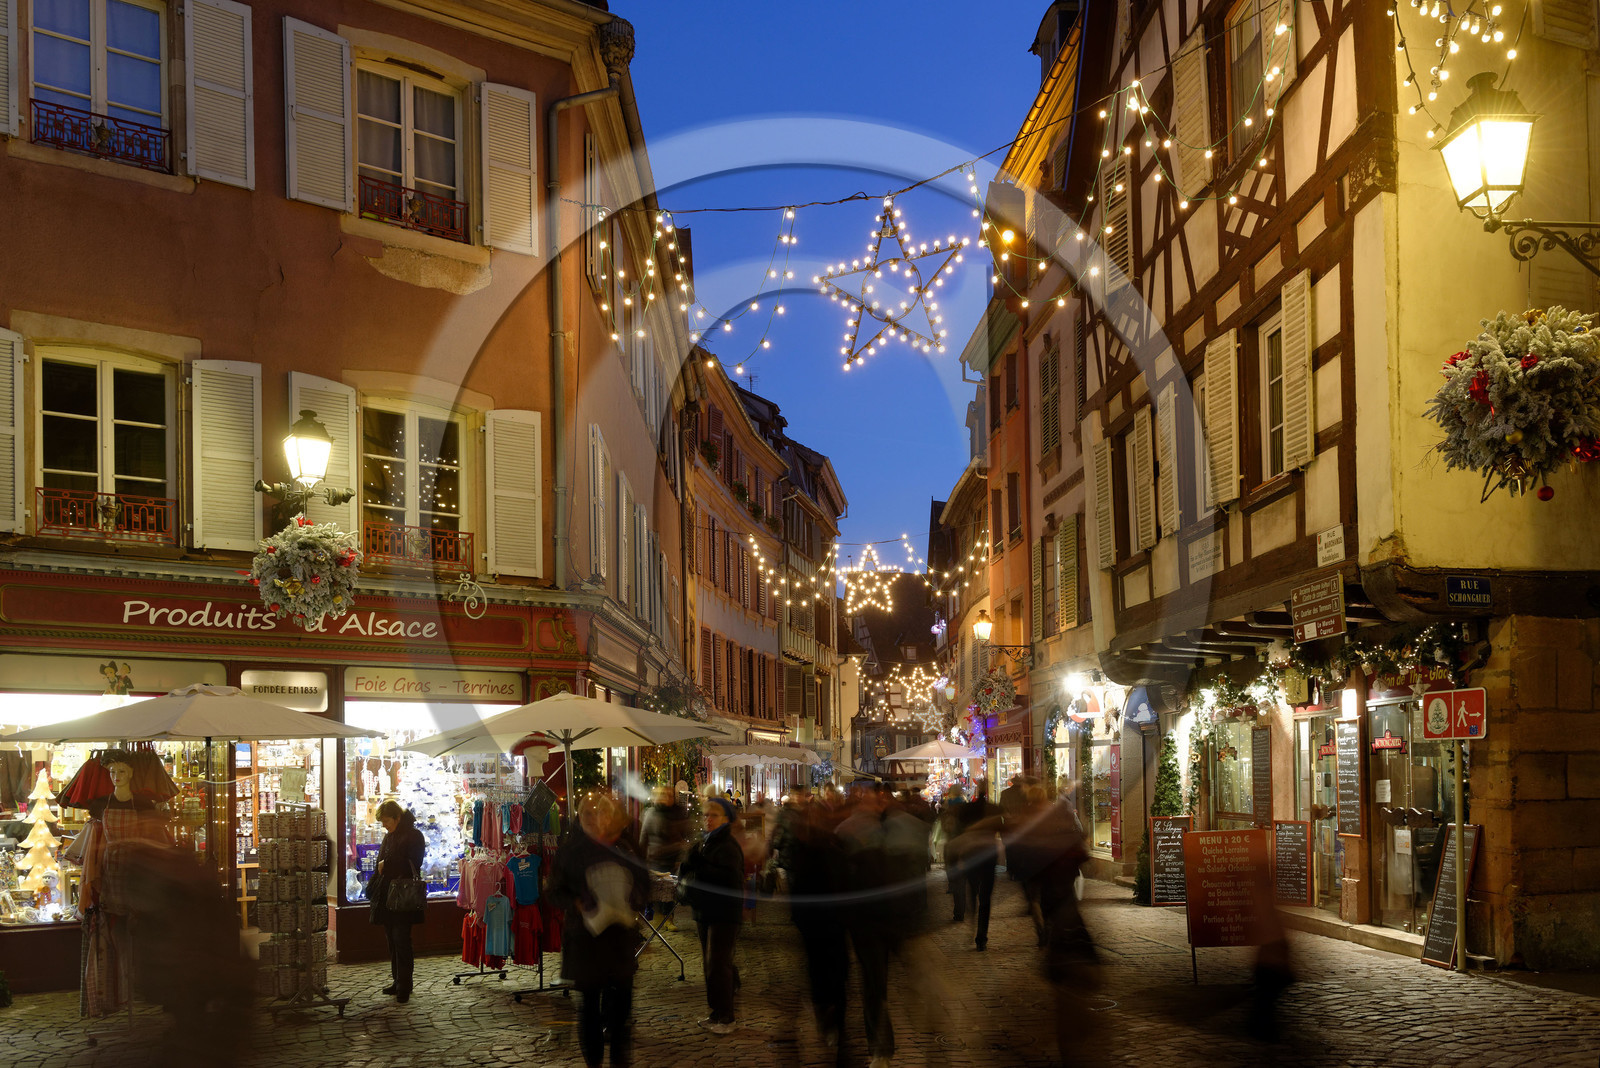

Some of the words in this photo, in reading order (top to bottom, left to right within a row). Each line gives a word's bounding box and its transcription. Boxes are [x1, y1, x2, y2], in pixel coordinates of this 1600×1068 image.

[1460, 580, 1479, 590] RUE
[1449, 592, 1491, 604] SCHONGAUER
[123, 600, 277, 630] Produits
[288, 686, 299, 694] EN
[301, 686, 318, 694] 1833
[354, 675, 388, 692] Foie
[392, 677, 431, 693] Gras
[453, 679, 515, 695] Terrines
[1199, 835, 1222, 845] MENU
[1224, 835, 1229, 844] à
[1231, 835, 1242, 843] 20
[1244, 835, 1250, 843] €
[1202, 846, 1223, 856] Quiche
[1224, 845, 1249, 854] Lorraine
[1212, 855, 1228, 863] Tarte
[1229, 856, 1250, 866] oignon
[1206, 864, 1226, 873] Salade
[1201, 880, 1235, 888] Choucroute
[1203, 915, 1225, 923] Portion
